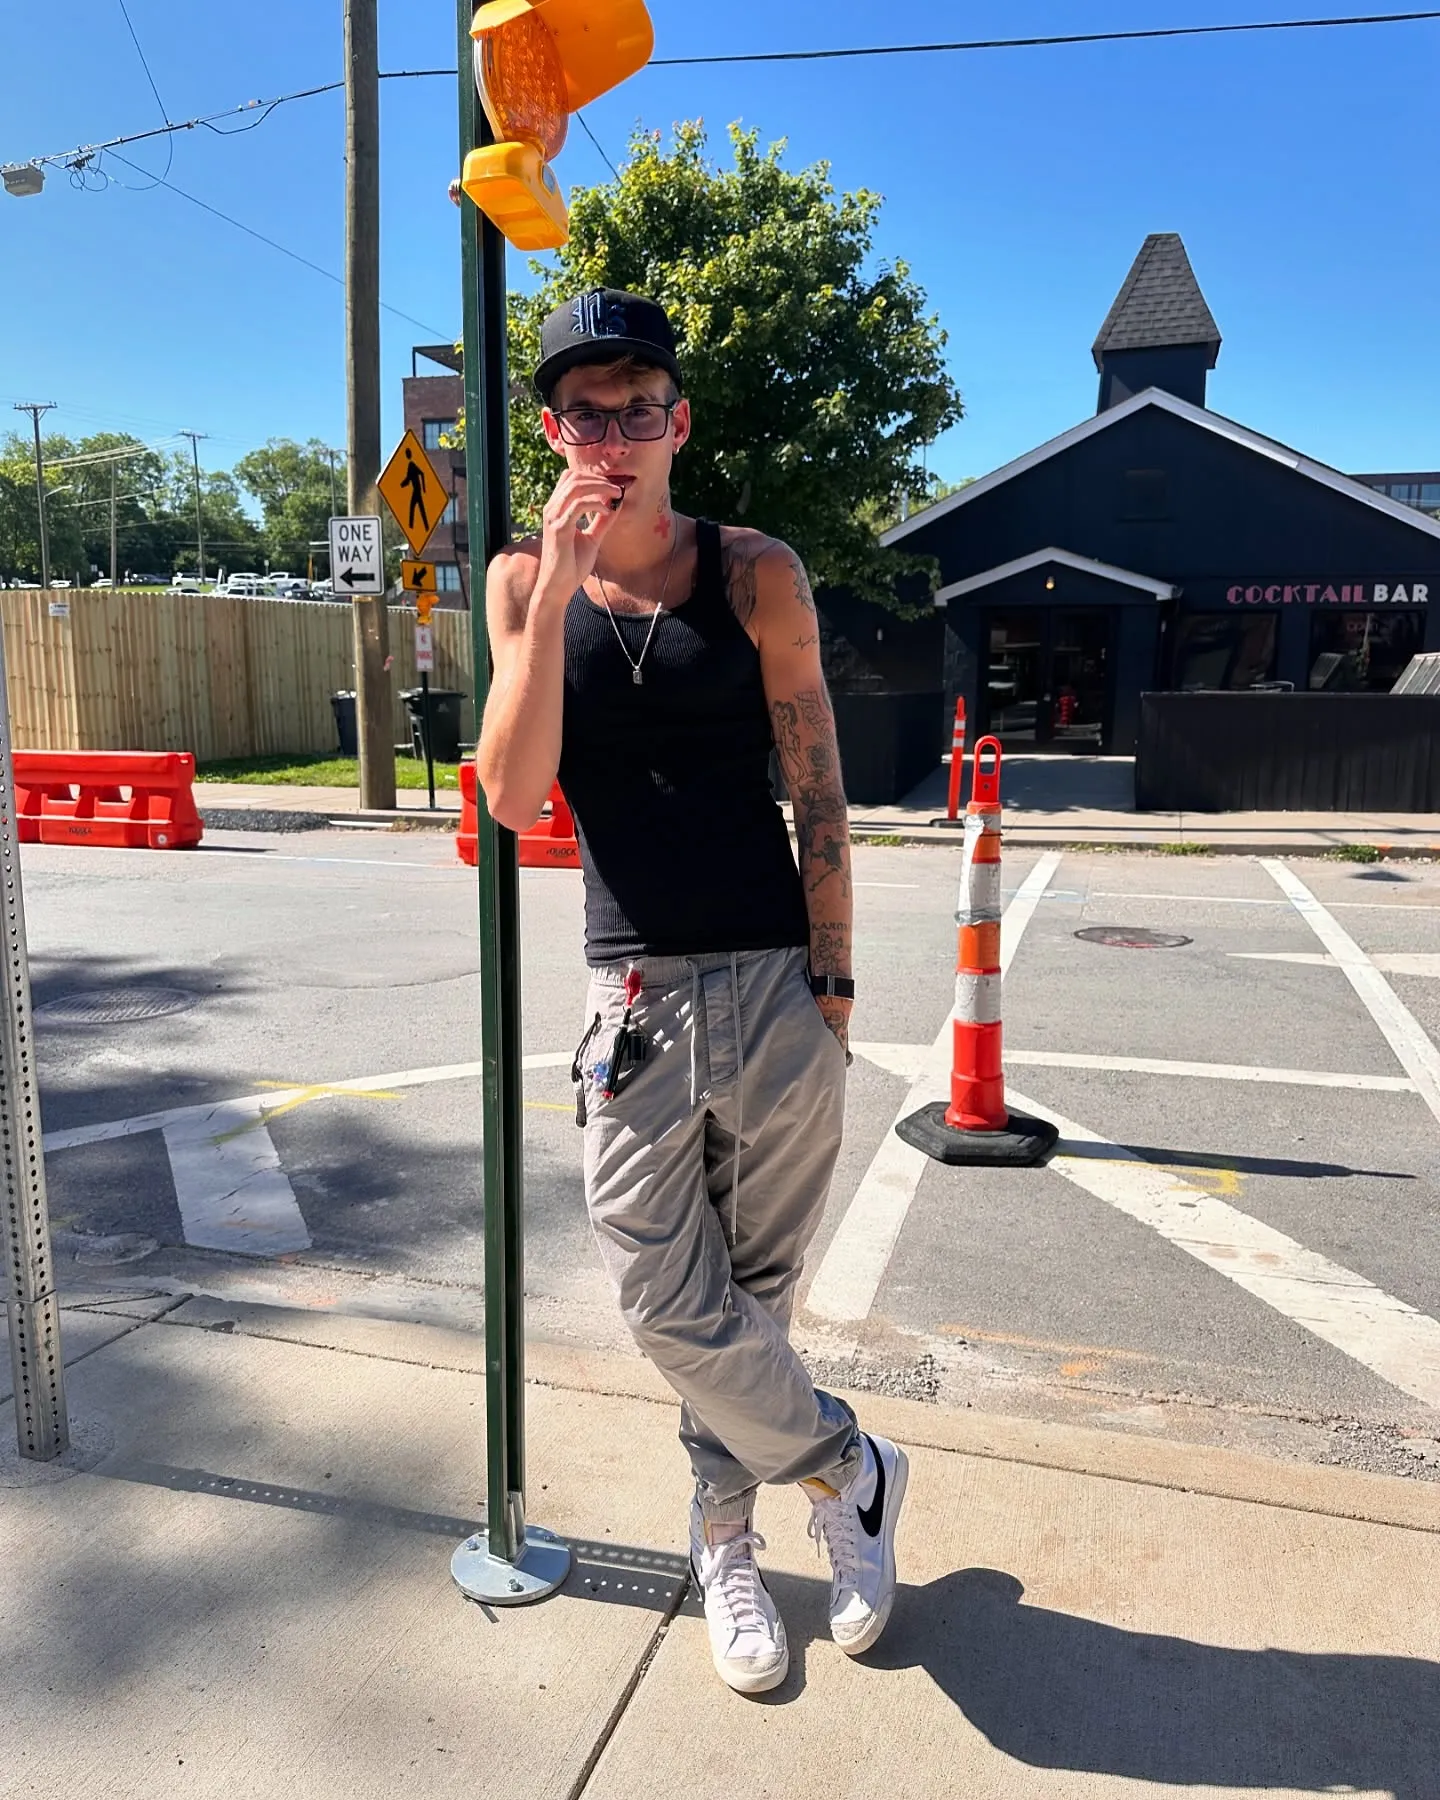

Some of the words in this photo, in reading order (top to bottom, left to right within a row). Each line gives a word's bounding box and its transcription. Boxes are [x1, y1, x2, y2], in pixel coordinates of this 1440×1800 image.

[338, 523, 372, 542] ONE
[338, 545, 373, 563] WAY
[1226, 584, 1368, 605] COCKTAIL
[1373, 583, 1429, 603] BAR
